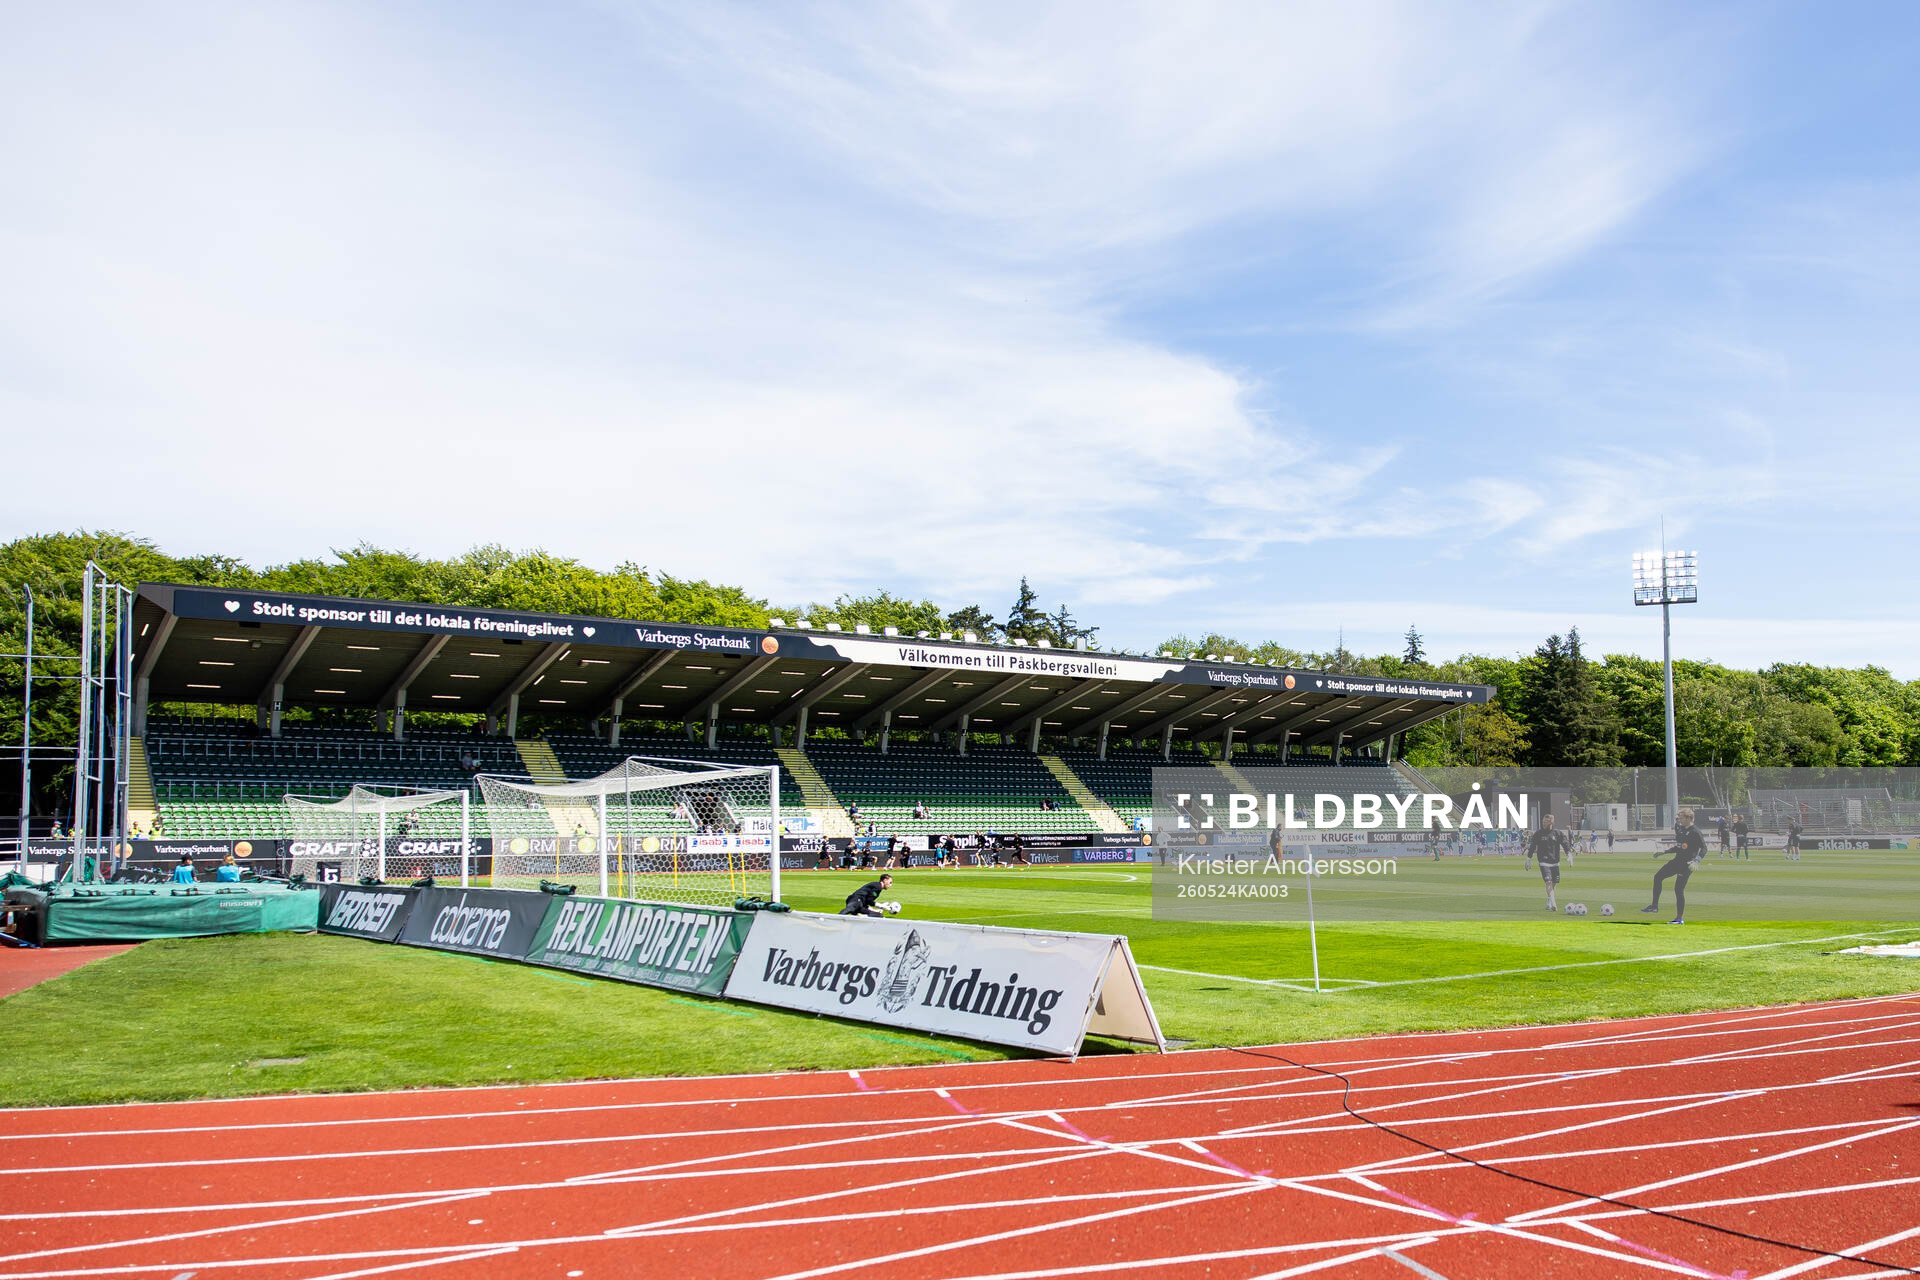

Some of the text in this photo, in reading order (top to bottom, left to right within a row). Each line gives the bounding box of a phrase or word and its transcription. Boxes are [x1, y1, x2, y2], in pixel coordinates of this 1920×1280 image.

[252, 601, 574, 637] Stolt sponsor till det lokala föreningslivet
[634, 628, 752, 650] Varbergs Sparbank
[898, 647, 1118, 676] Välkommen till Påskbergsvallen!
[1207, 670, 1279, 687] Varbergs Sparbank
[1327, 679, 1463, 699] Stolt sponsor till det lokala föreningslivet
[1321, 833, 1354, 843] KRUGE
[1817, 839, 1870, 850] skkab.se
[28, 846, 67, 857] Varbergs
[191, 844, 230, 856] Sparbank
[289, 841, 362, 856] CRAFT
[398, 841, 464, 855] CRAFT
[1084, 851, 1124, 861] VARBERG
[1029, 853, 1060, 863] TriWest
[430, 892, 511, 949] colorama
[546, 900, 733, 975] REKLAMPORTEN!
[762, 945, 880, 1005] Varbergs
[921, 964, 1064, 1036] Tidning
